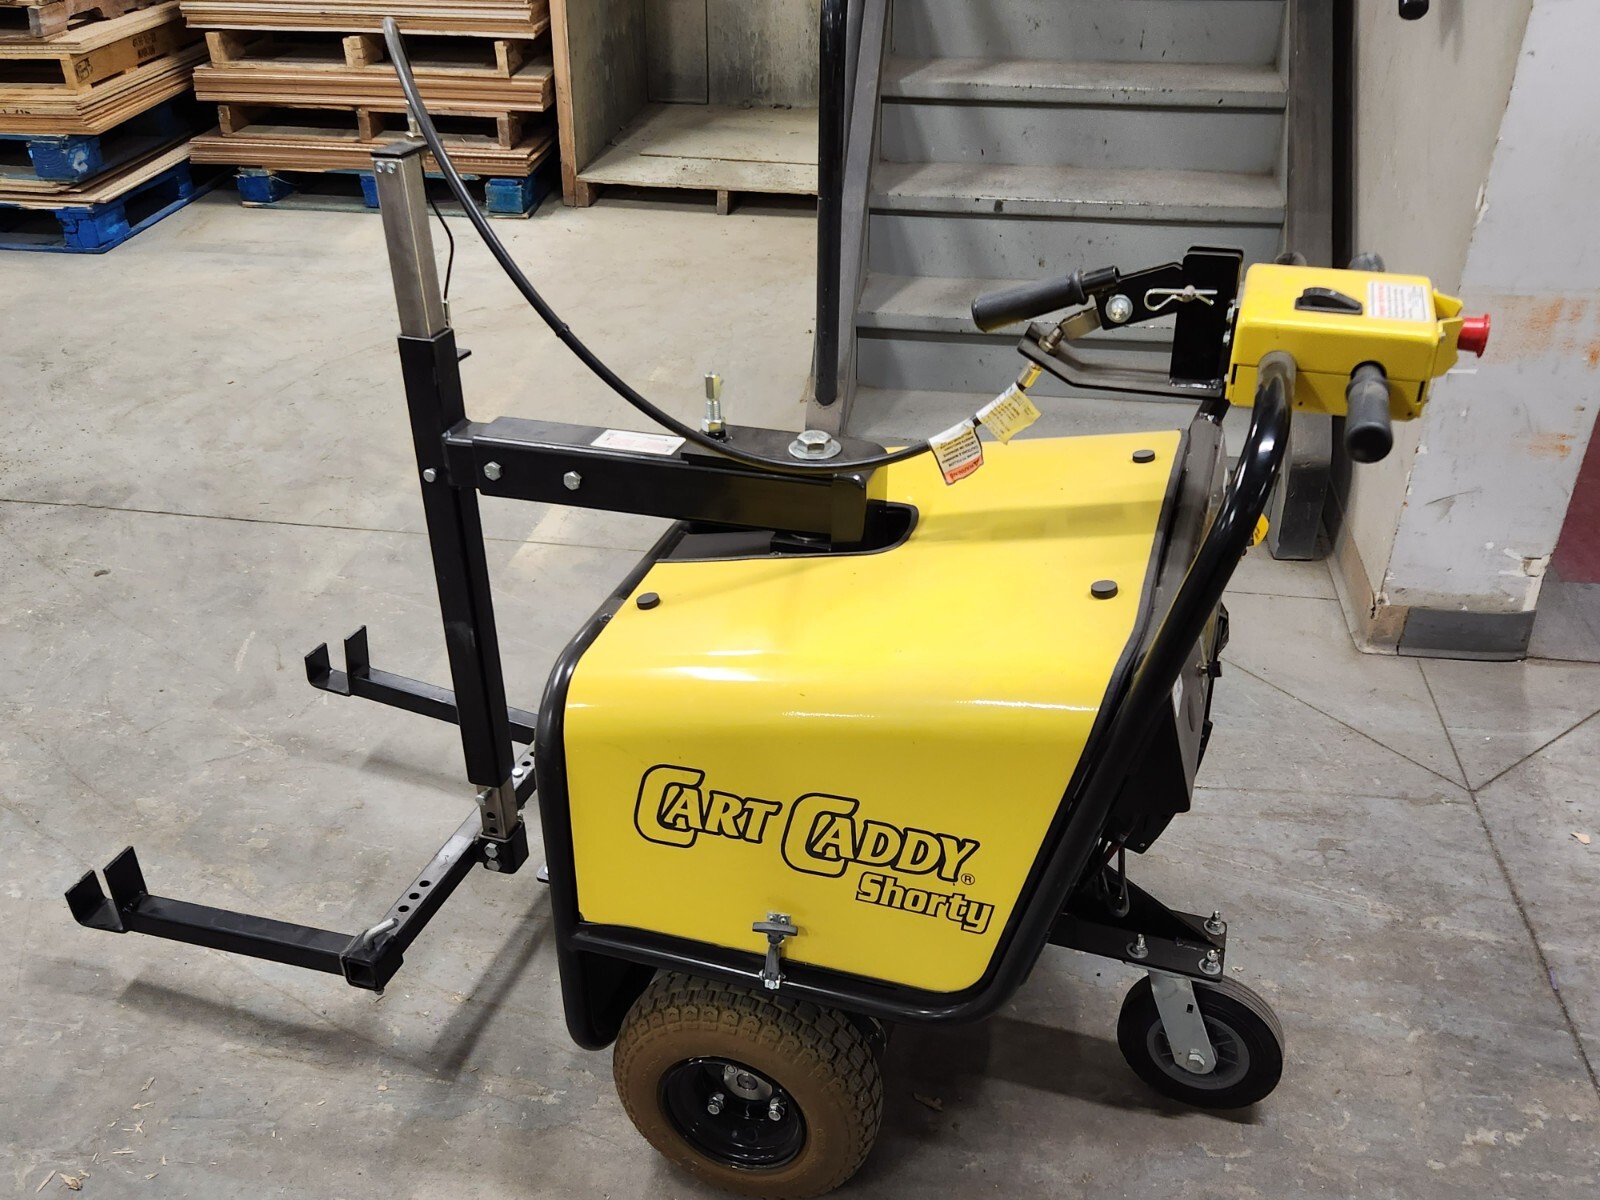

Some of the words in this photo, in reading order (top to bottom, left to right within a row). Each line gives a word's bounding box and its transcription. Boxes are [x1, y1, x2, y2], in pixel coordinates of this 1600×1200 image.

[633, 763, 782, 848] CART
[780, 792, 980, 882] CADDY
[855, 871, 995, 934] Shorty
